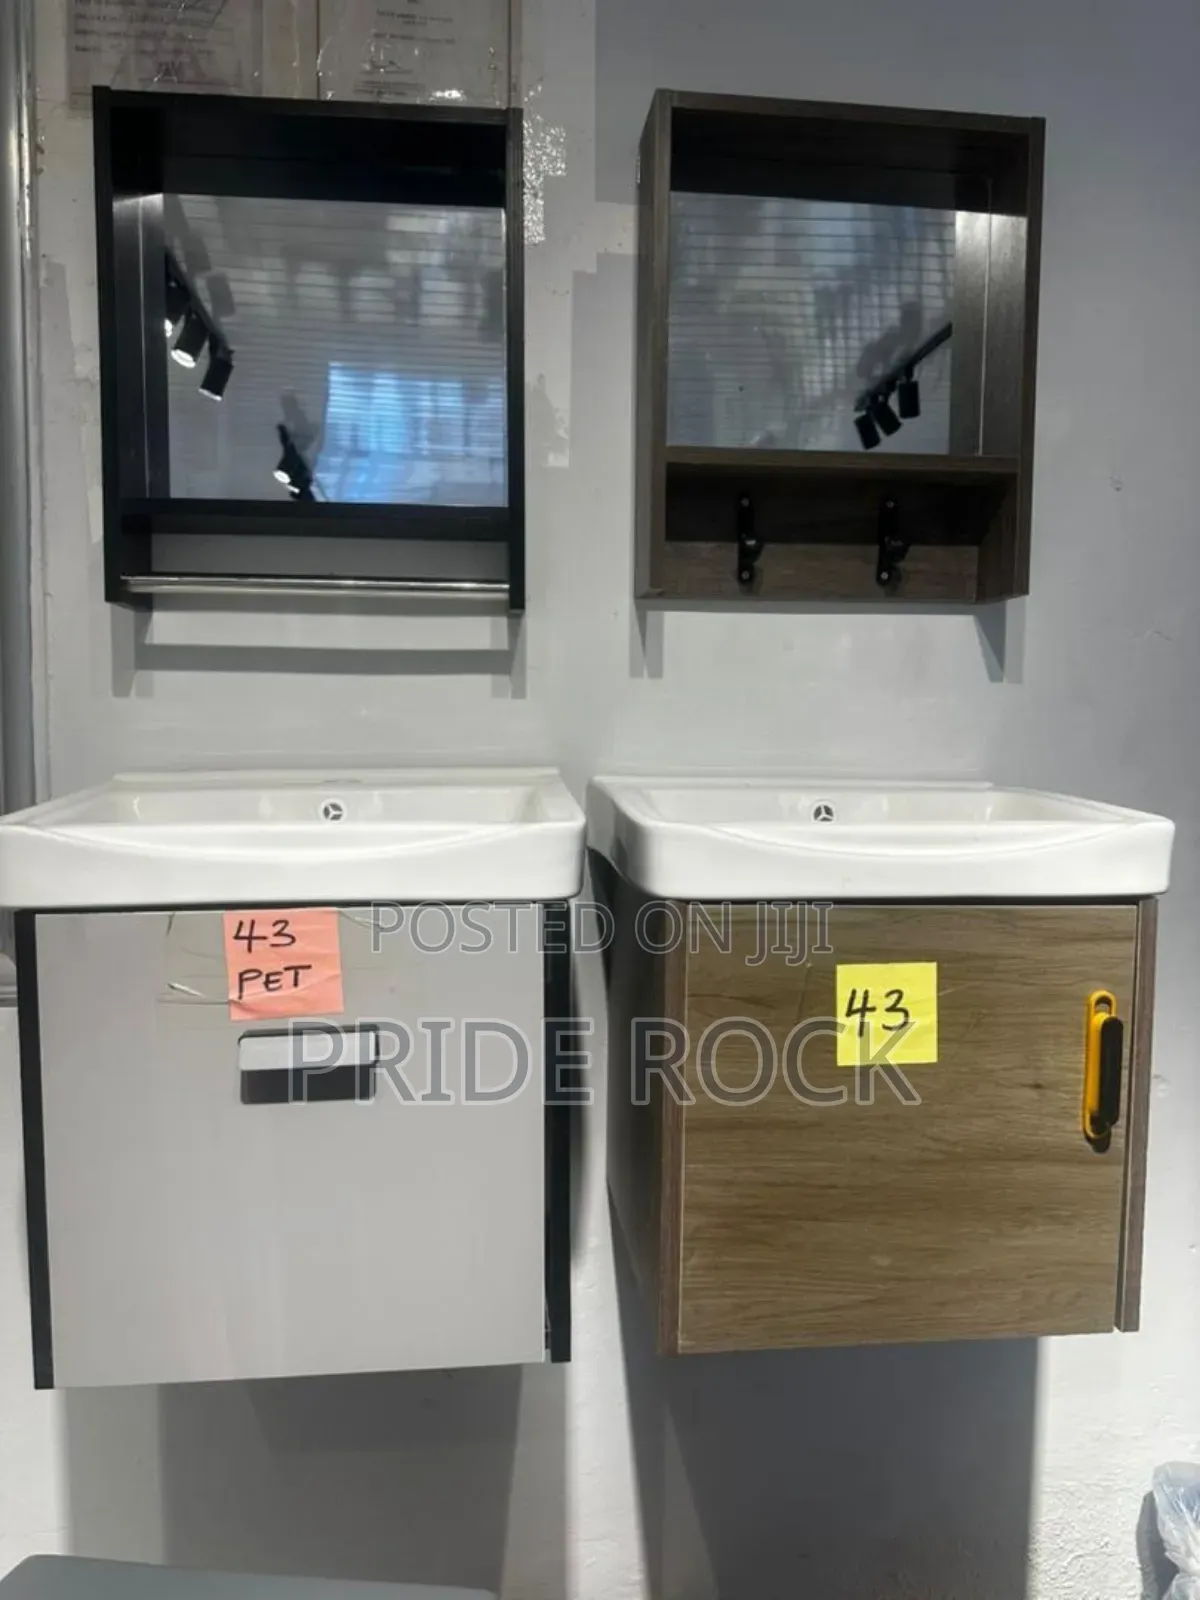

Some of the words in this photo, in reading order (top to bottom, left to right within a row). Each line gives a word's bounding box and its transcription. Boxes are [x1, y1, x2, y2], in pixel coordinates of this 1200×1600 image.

[232, 919, 298, 954] 43
[237, 964, 313, 1000] PET
[845, 988, 910, 1038] 43
